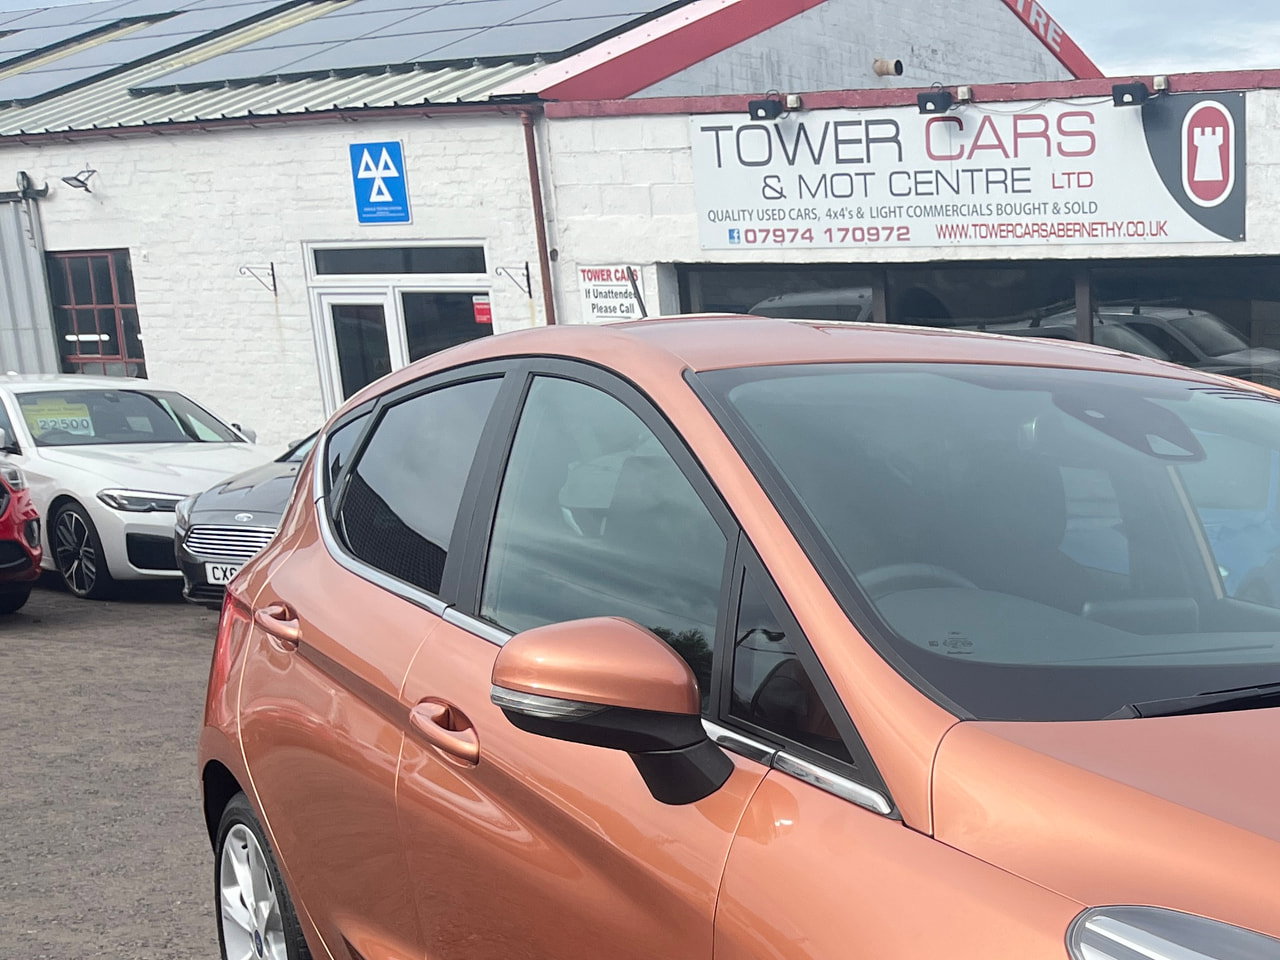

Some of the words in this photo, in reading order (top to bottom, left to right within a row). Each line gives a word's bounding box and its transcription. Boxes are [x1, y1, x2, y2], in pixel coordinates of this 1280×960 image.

[700, 118, 903, 168] TOWER
[925, 110, 1096, 161] CARS
[762, 174, 787, 200] &
[798, 172, 875, 199] MOT
[888, 167, 1032, 197] CENTRE
[1051, 171, 1093, 189] LTD
[707, 209, 754, 223] QUALITY
[757, 208, 785, 221] USED
[788, 207, 821, 221] CARS,
[825, 207, 853, 220] 4x4's
[856, 207, 865, 219] &
[870, 205, 903, 219] LIGHT
[906, 203, 993, 218] COMMERCIALS
[996, 202, 1048, 216] BOUGHT
[1052, 202, 1061, 215] &
[1064, 201, 1098, 215] SOLD
[744, 228, 814, 243] 07974
[824, 226, 911, 243] 170972
[935, 220, 1168, 239] WWW.TOWERCARSABERNETHY.CO.UK
[580, 268, 612, 282] TOWER
[614, 268, 639, 282] CAS
[592, 287, 636, 299] Unattende
[591, 302, 617, 313] Please
[619, 302, 635, 313] Call
[39, 418, 90, 430] 22500
